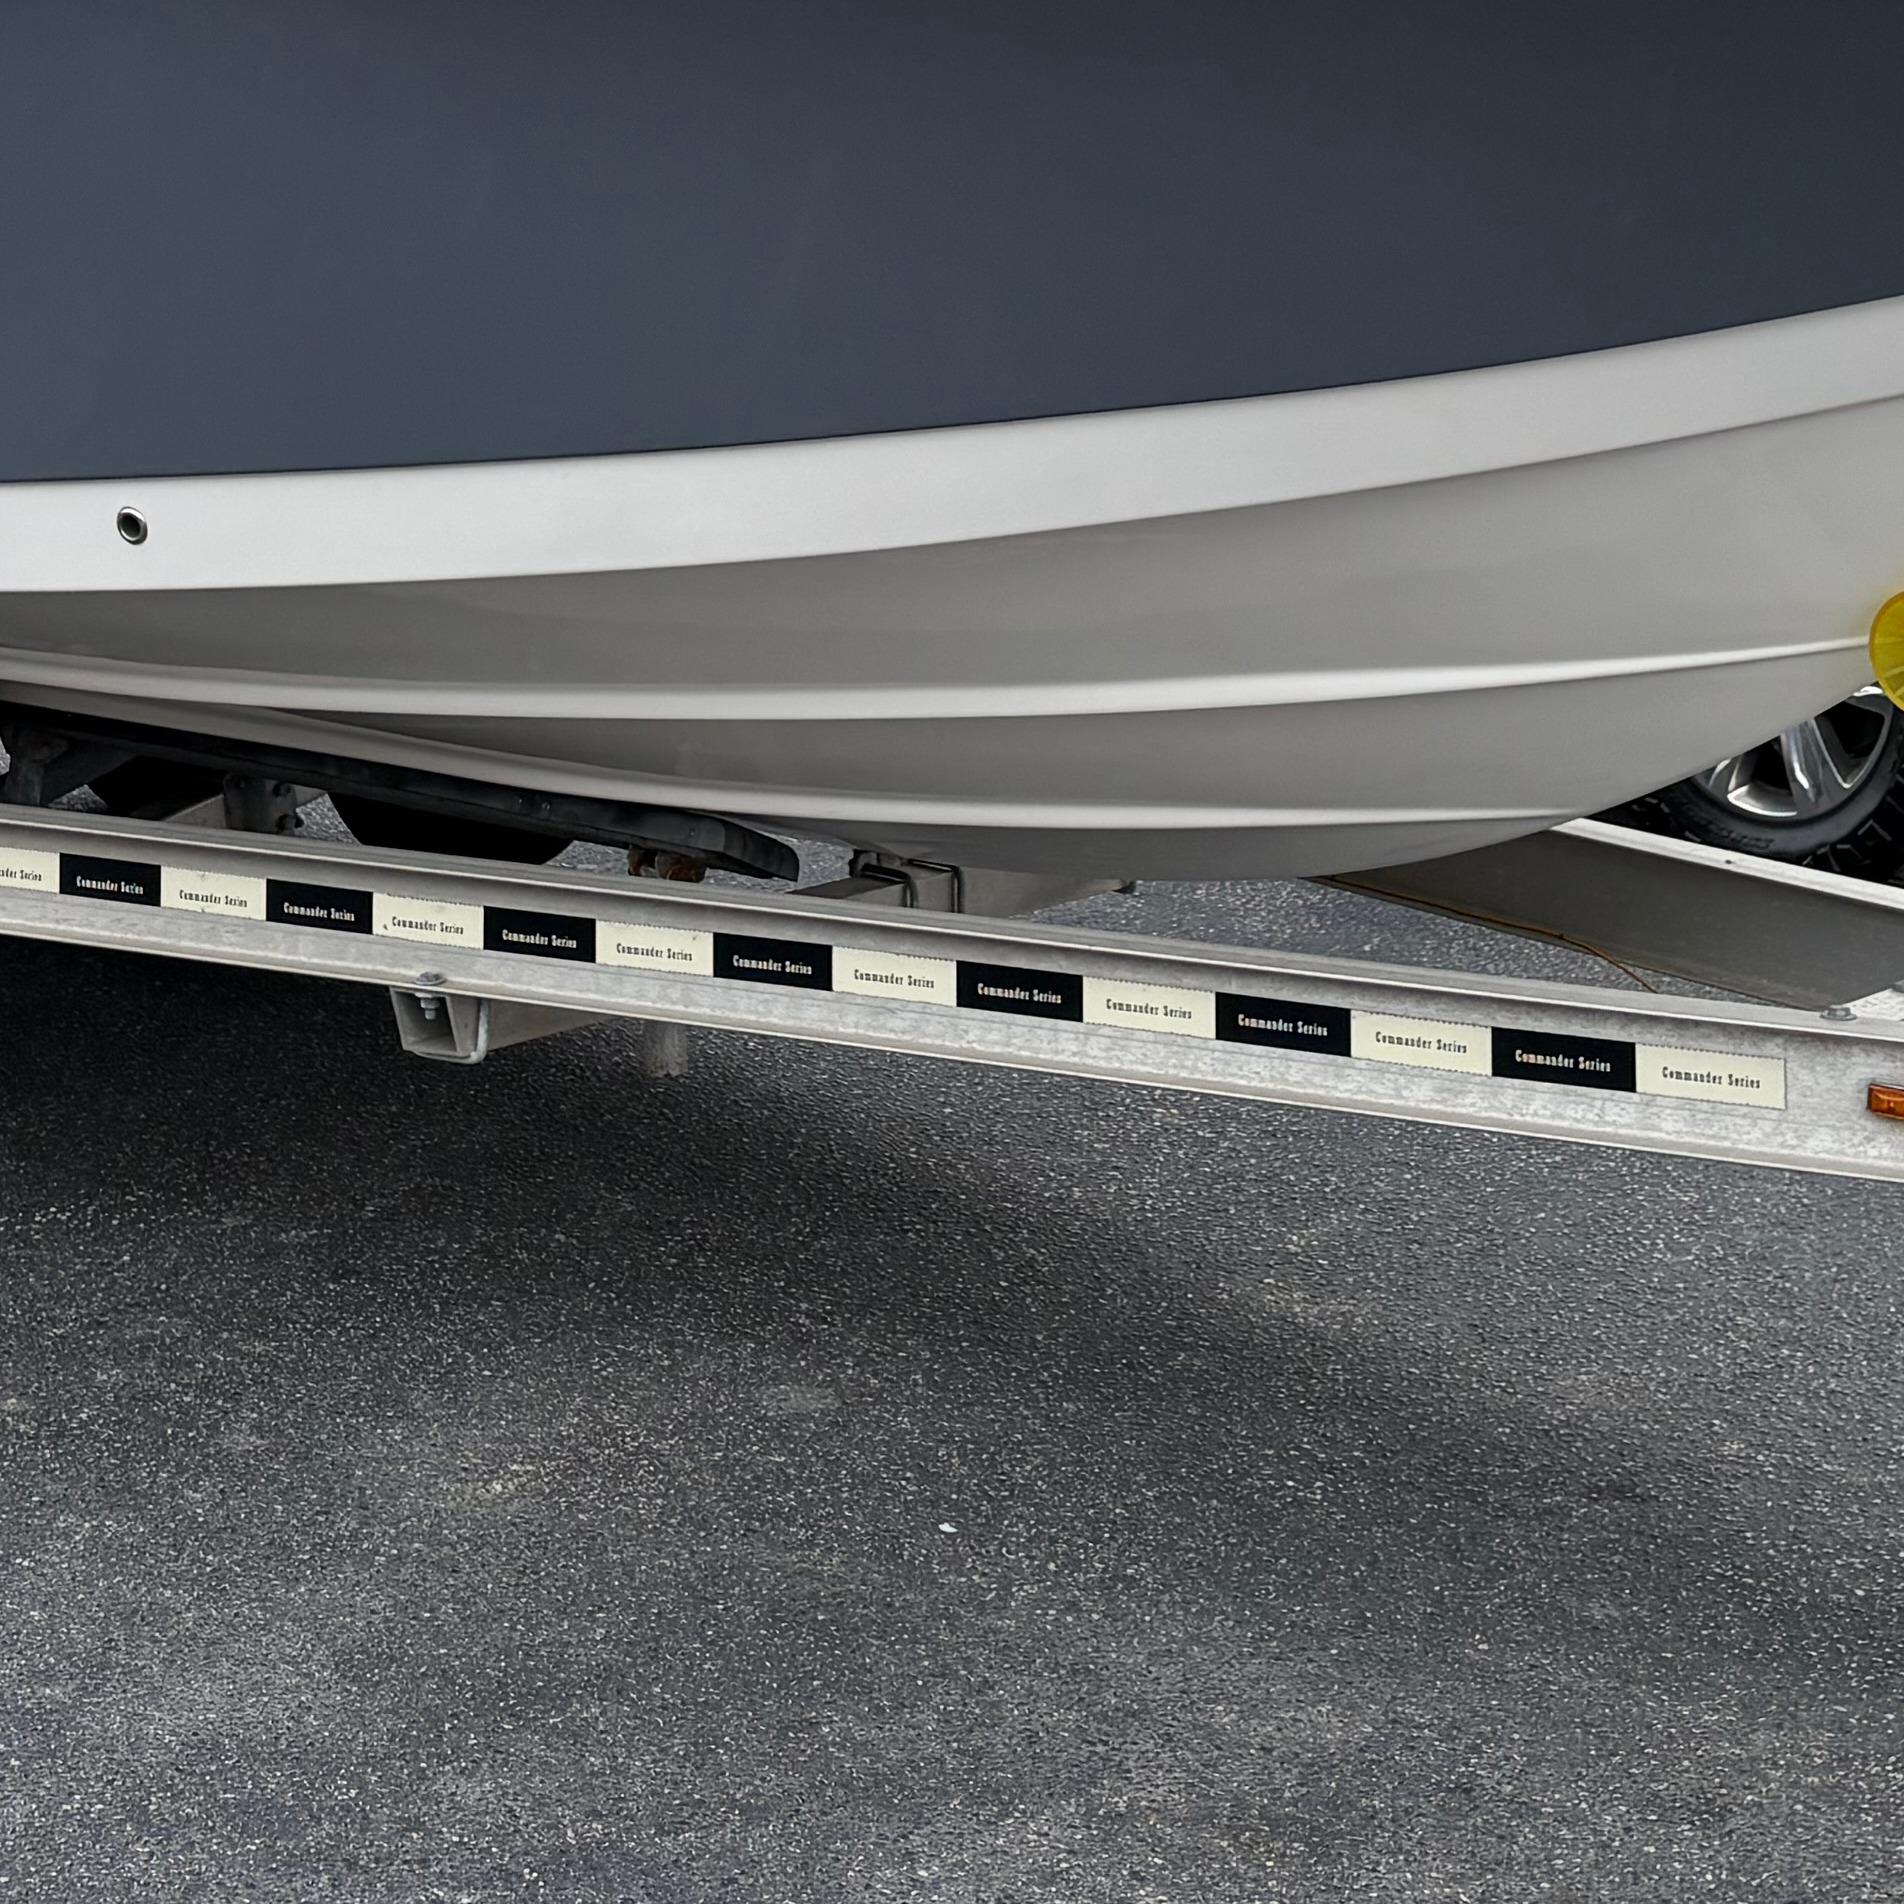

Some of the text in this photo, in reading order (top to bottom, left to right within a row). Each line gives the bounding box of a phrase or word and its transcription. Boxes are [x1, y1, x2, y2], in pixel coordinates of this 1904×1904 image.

[76, 876, 144, 894] Commander Series
[179, 889, 247, 908] Commander Series
[284, 902, 355, 922] Commander Series
[392, 916, 464, 935] Commander Series
[502, 929, 577, 948] Commander Series
[616, 943, 692, 961] Commander Series
[733, 955, 812, 975] Commander Series
[854, 969, 935, 988] Commander Series
[978, 983, 1062, 1004] Commander Series
[1106, 999, 1192, 1019] Commander Series
[1238, 1014, 1328, 1037] Commander Series
[1375, 1032, 1467, 1054] Commander Series
[1515, 1050, 1611, 1072] Commander Series
[1662, 1066, 1760, 1089] Commander Series
